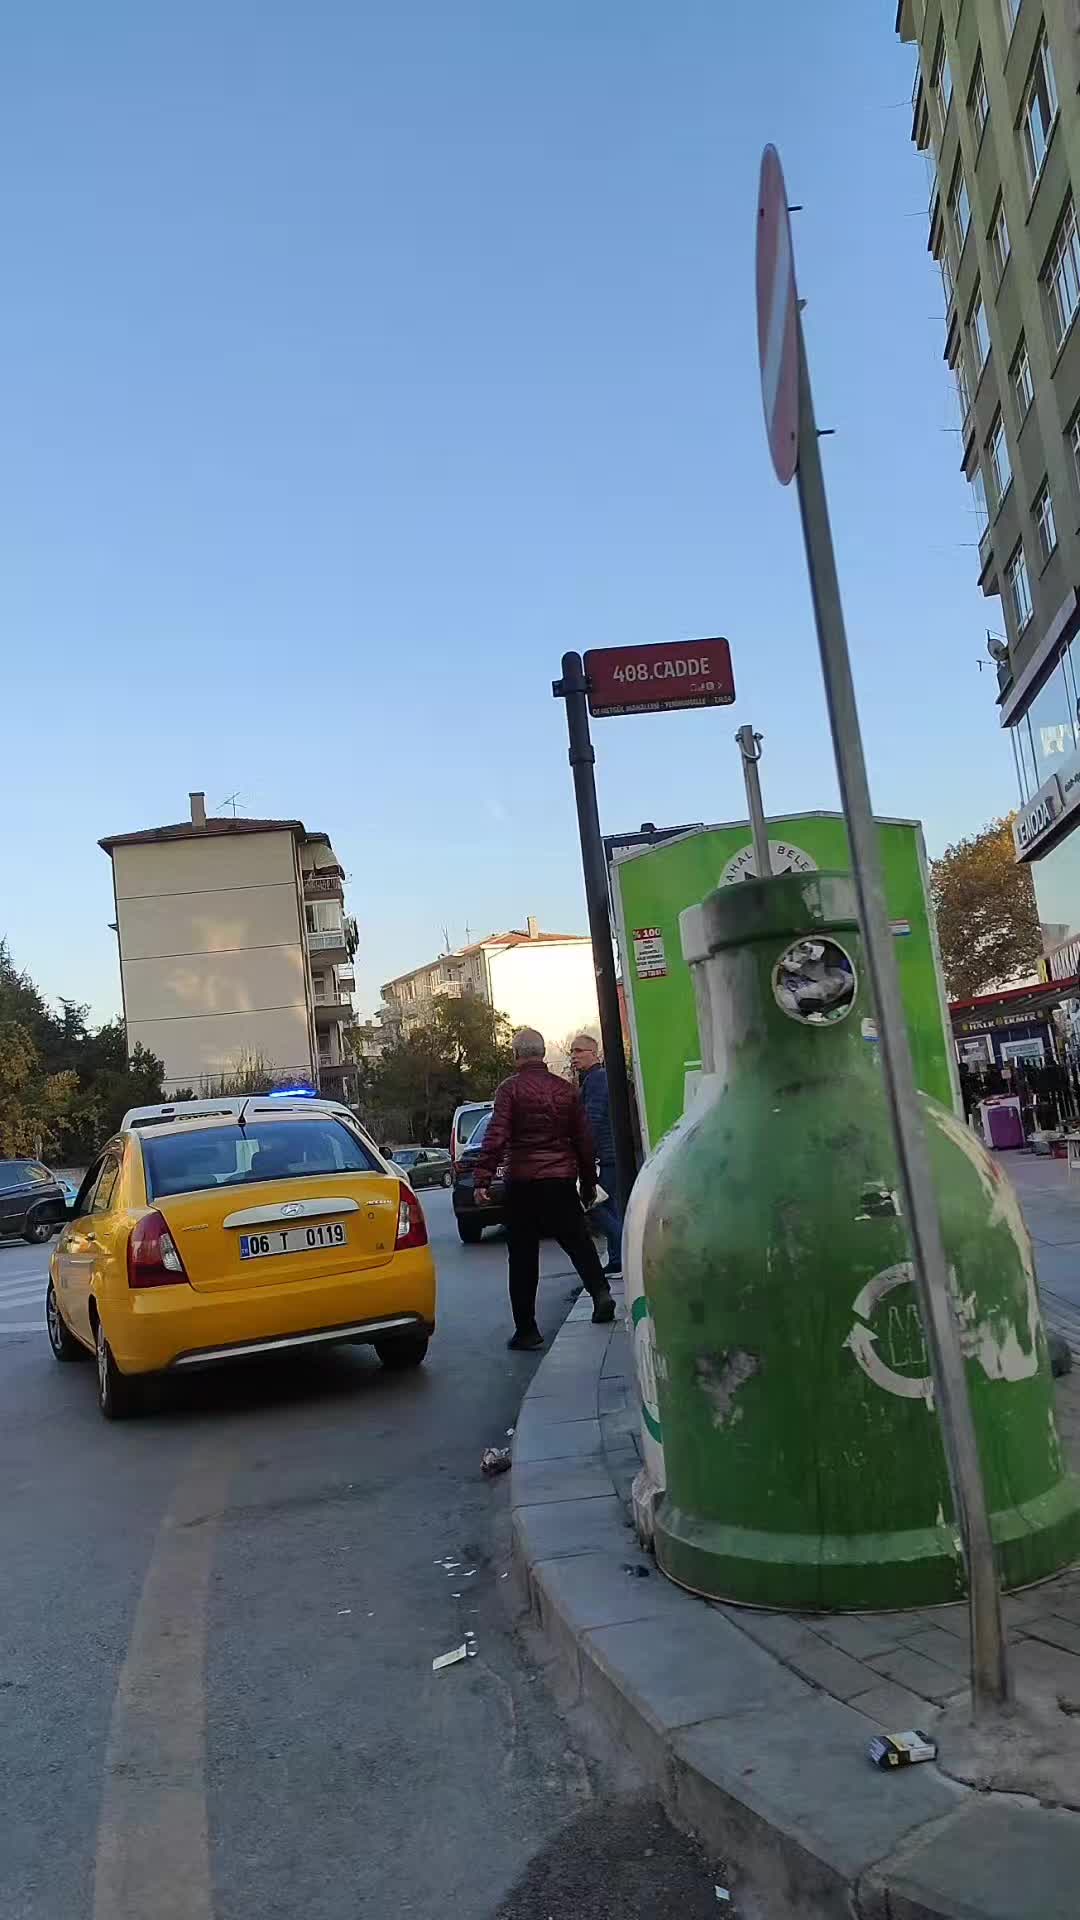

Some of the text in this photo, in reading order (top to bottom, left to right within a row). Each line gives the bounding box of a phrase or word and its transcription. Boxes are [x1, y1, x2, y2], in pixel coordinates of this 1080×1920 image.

[613, 657, 711, 682] 408.CADDE
[642, 928, 661, 938] 100
[250, 1235, 270, 1255] 06
[280, 1232, 289, 1250] T
[306, 1224, 344, 1247] 0119
